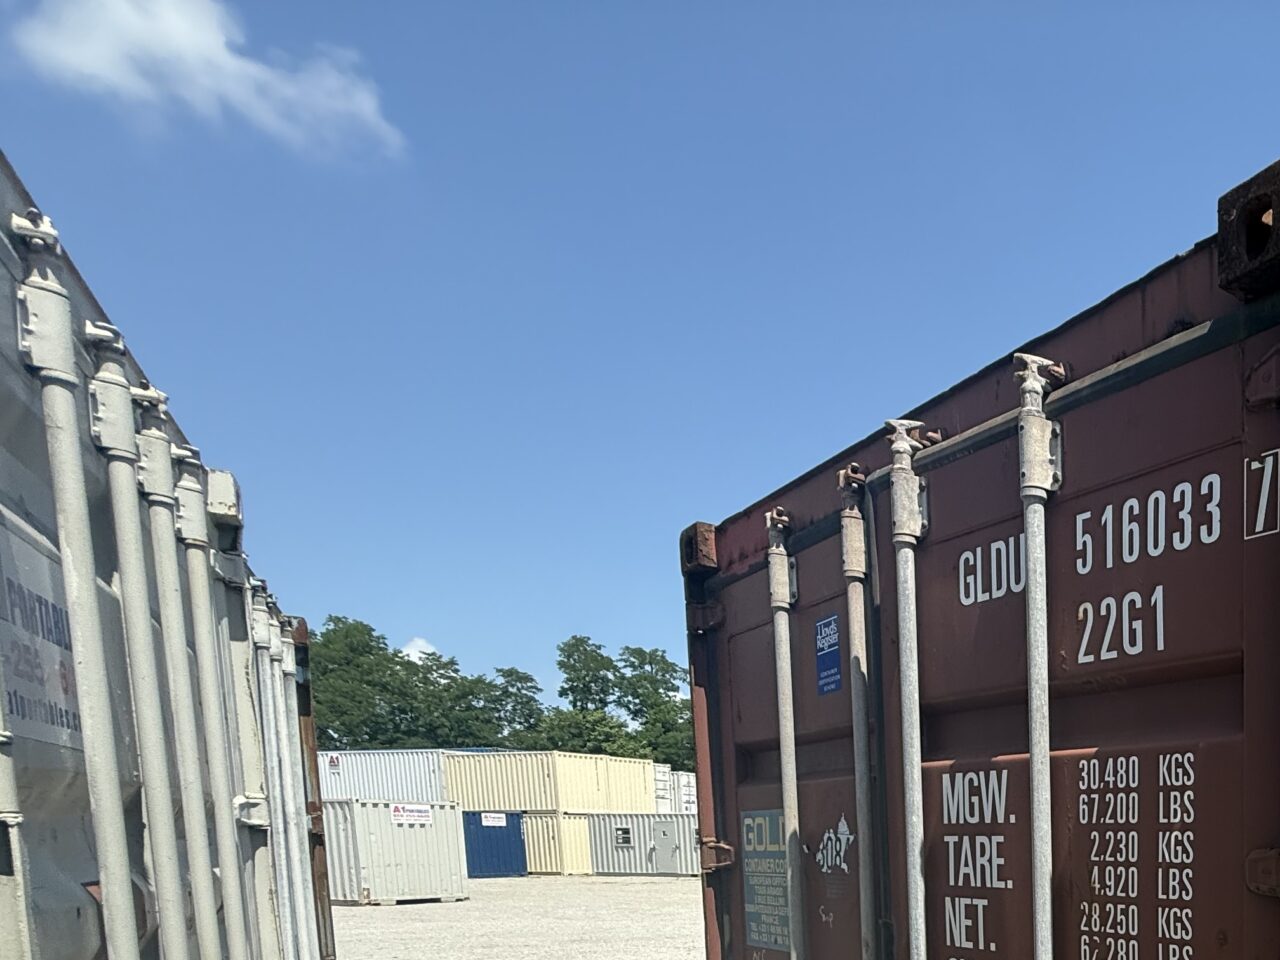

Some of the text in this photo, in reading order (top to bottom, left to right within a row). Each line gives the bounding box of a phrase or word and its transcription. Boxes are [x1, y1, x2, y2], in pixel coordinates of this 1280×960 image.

[959, 455, 1274, 606] GLDU 516033 7
[817, 633, 839, 650] Register
[1077, 585, 1165, 664] 22G1
[1079, 752, 1195, 790] 30,480 KGS
[942, 769, 1016, 825] MGW.
[1079, 790, 1195, 824] 67,200 LBS
[944, 835, 1013, 889] TARE.
[1090, 831, 1194, 864] 2,230 KGS
[1091, 865, 1193, 900] 4,920 LBS
[944, 896, 996, 951] NET.
[1080, 901, 1193, 941] 28,250 KGS
